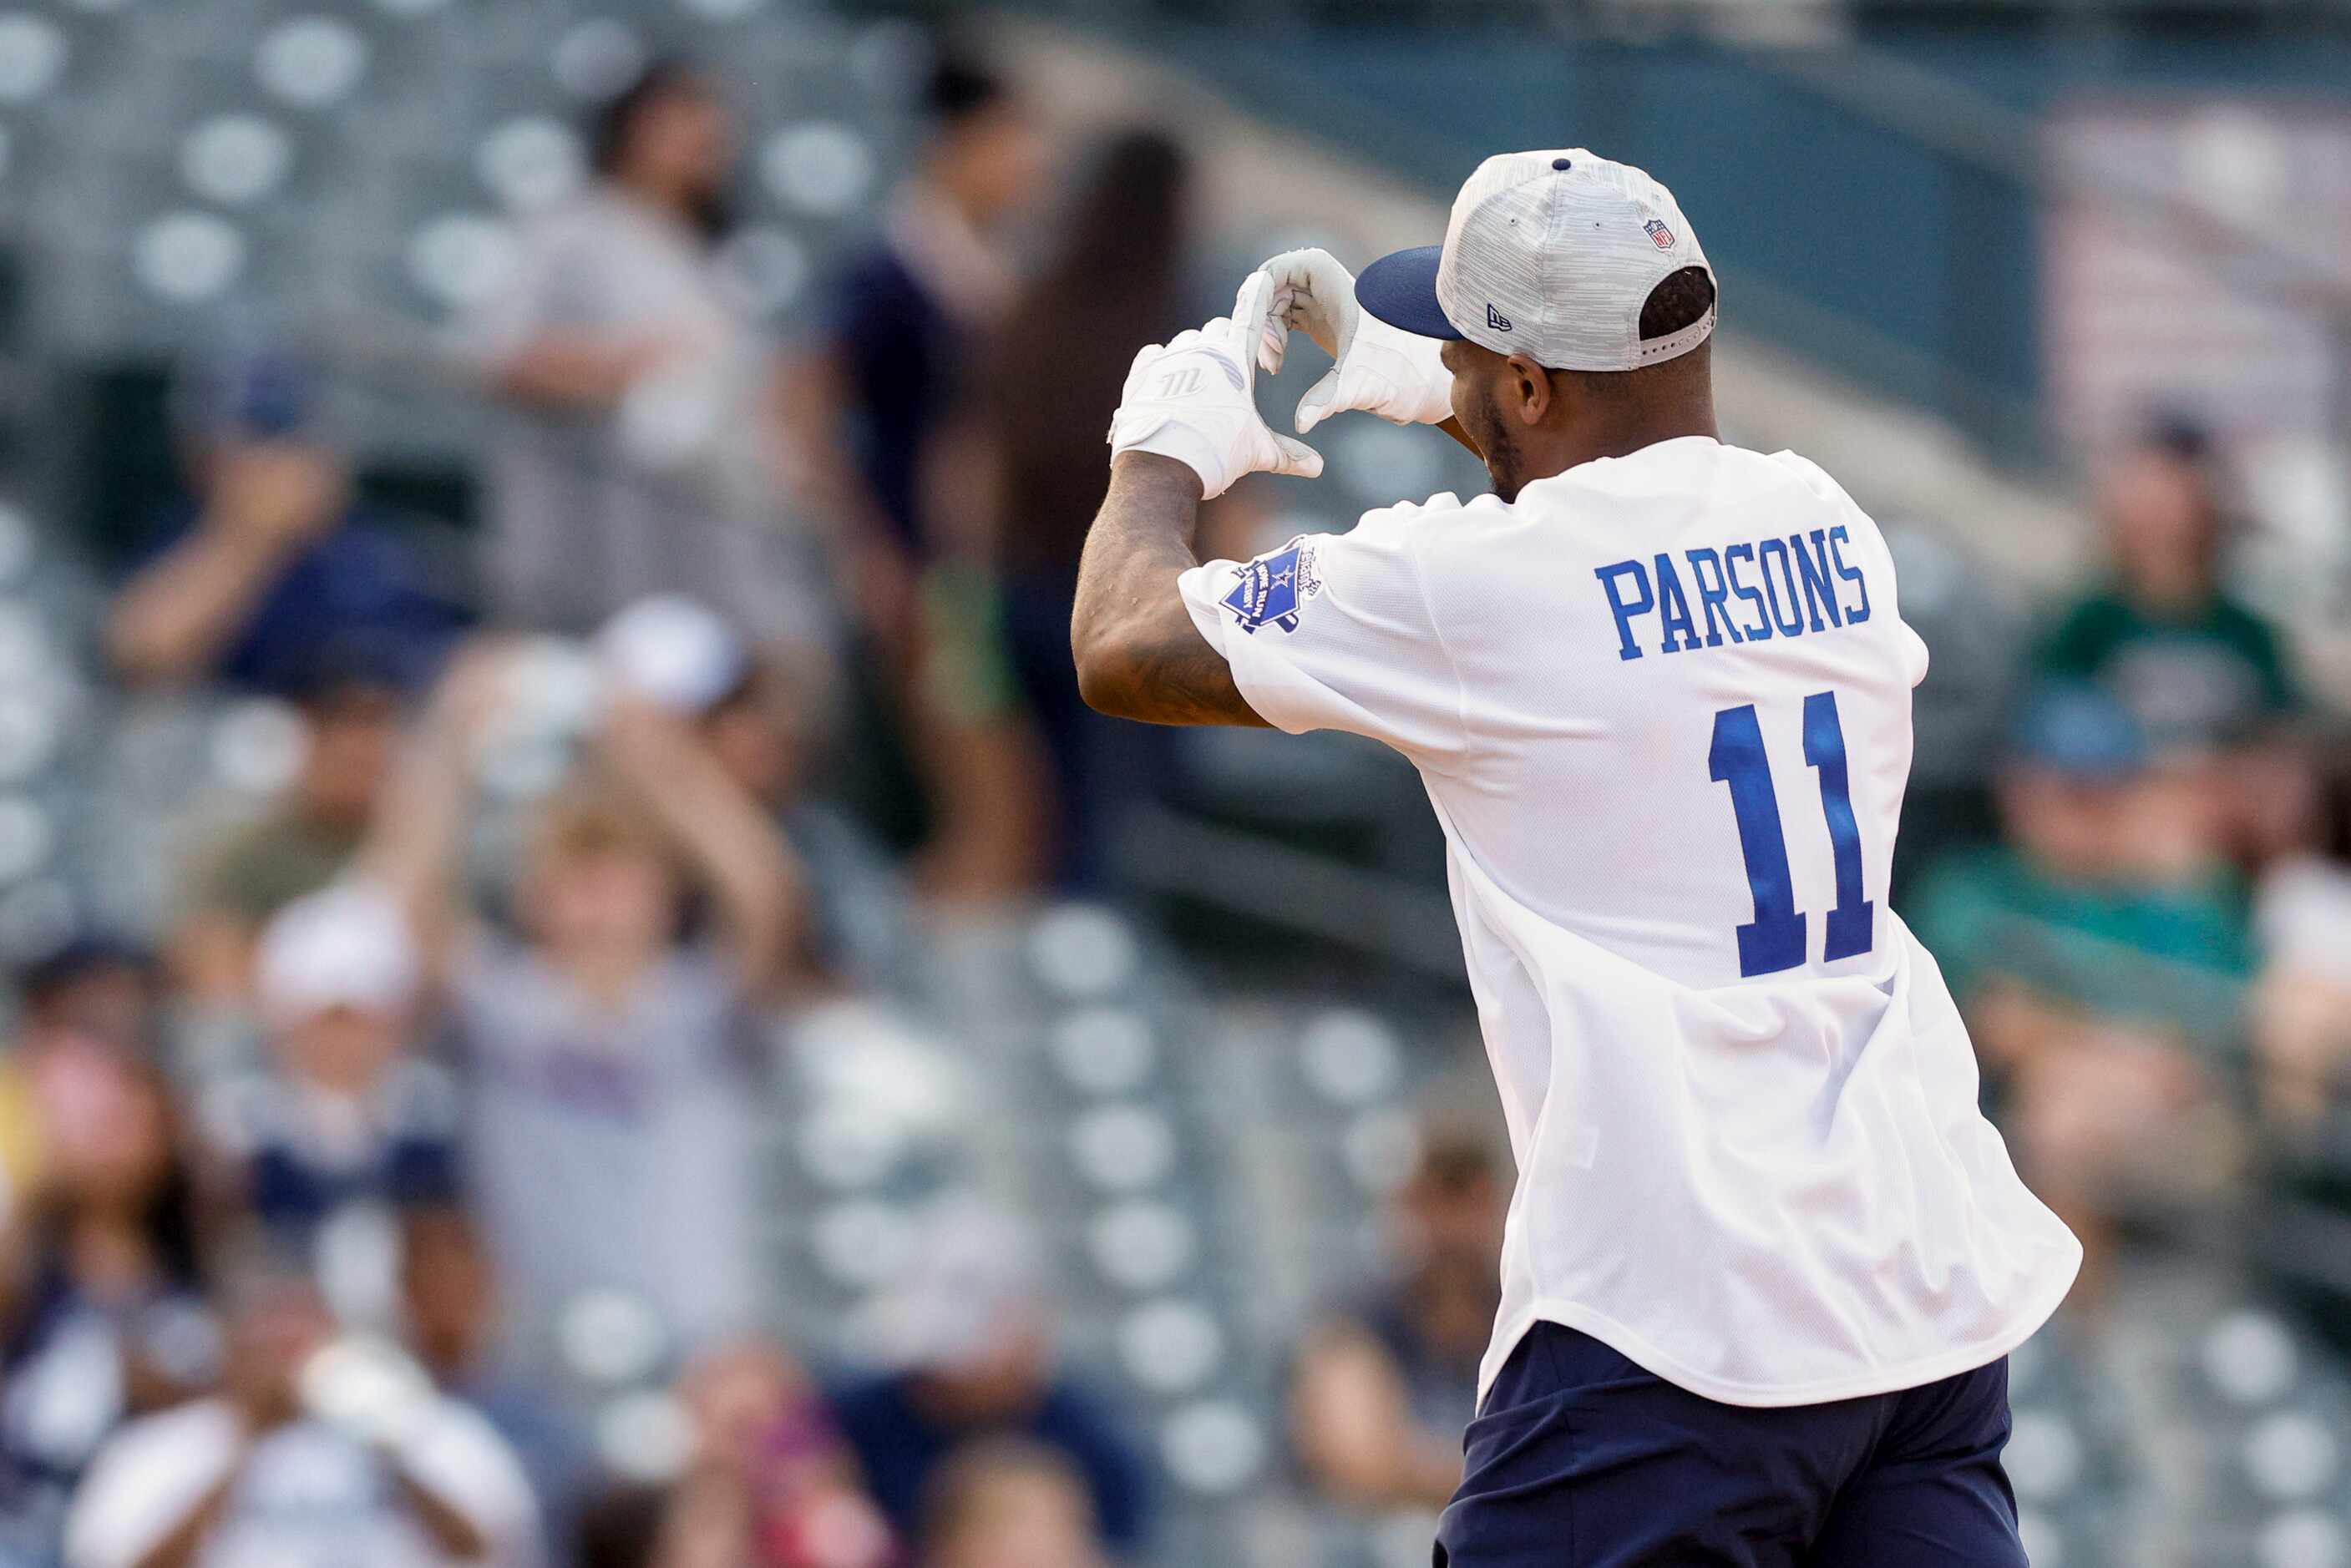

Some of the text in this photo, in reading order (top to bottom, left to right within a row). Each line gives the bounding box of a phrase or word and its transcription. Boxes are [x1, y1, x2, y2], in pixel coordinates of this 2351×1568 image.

[1652, 229, 1672, 247] NFL
[1243, 576, 1254, 609] DERBY
[1252, 564, 1269, 618] HOME RUN
[1594, 525, 1871, 660] PARSONS
[1708, 690, 1873, 977] 11
